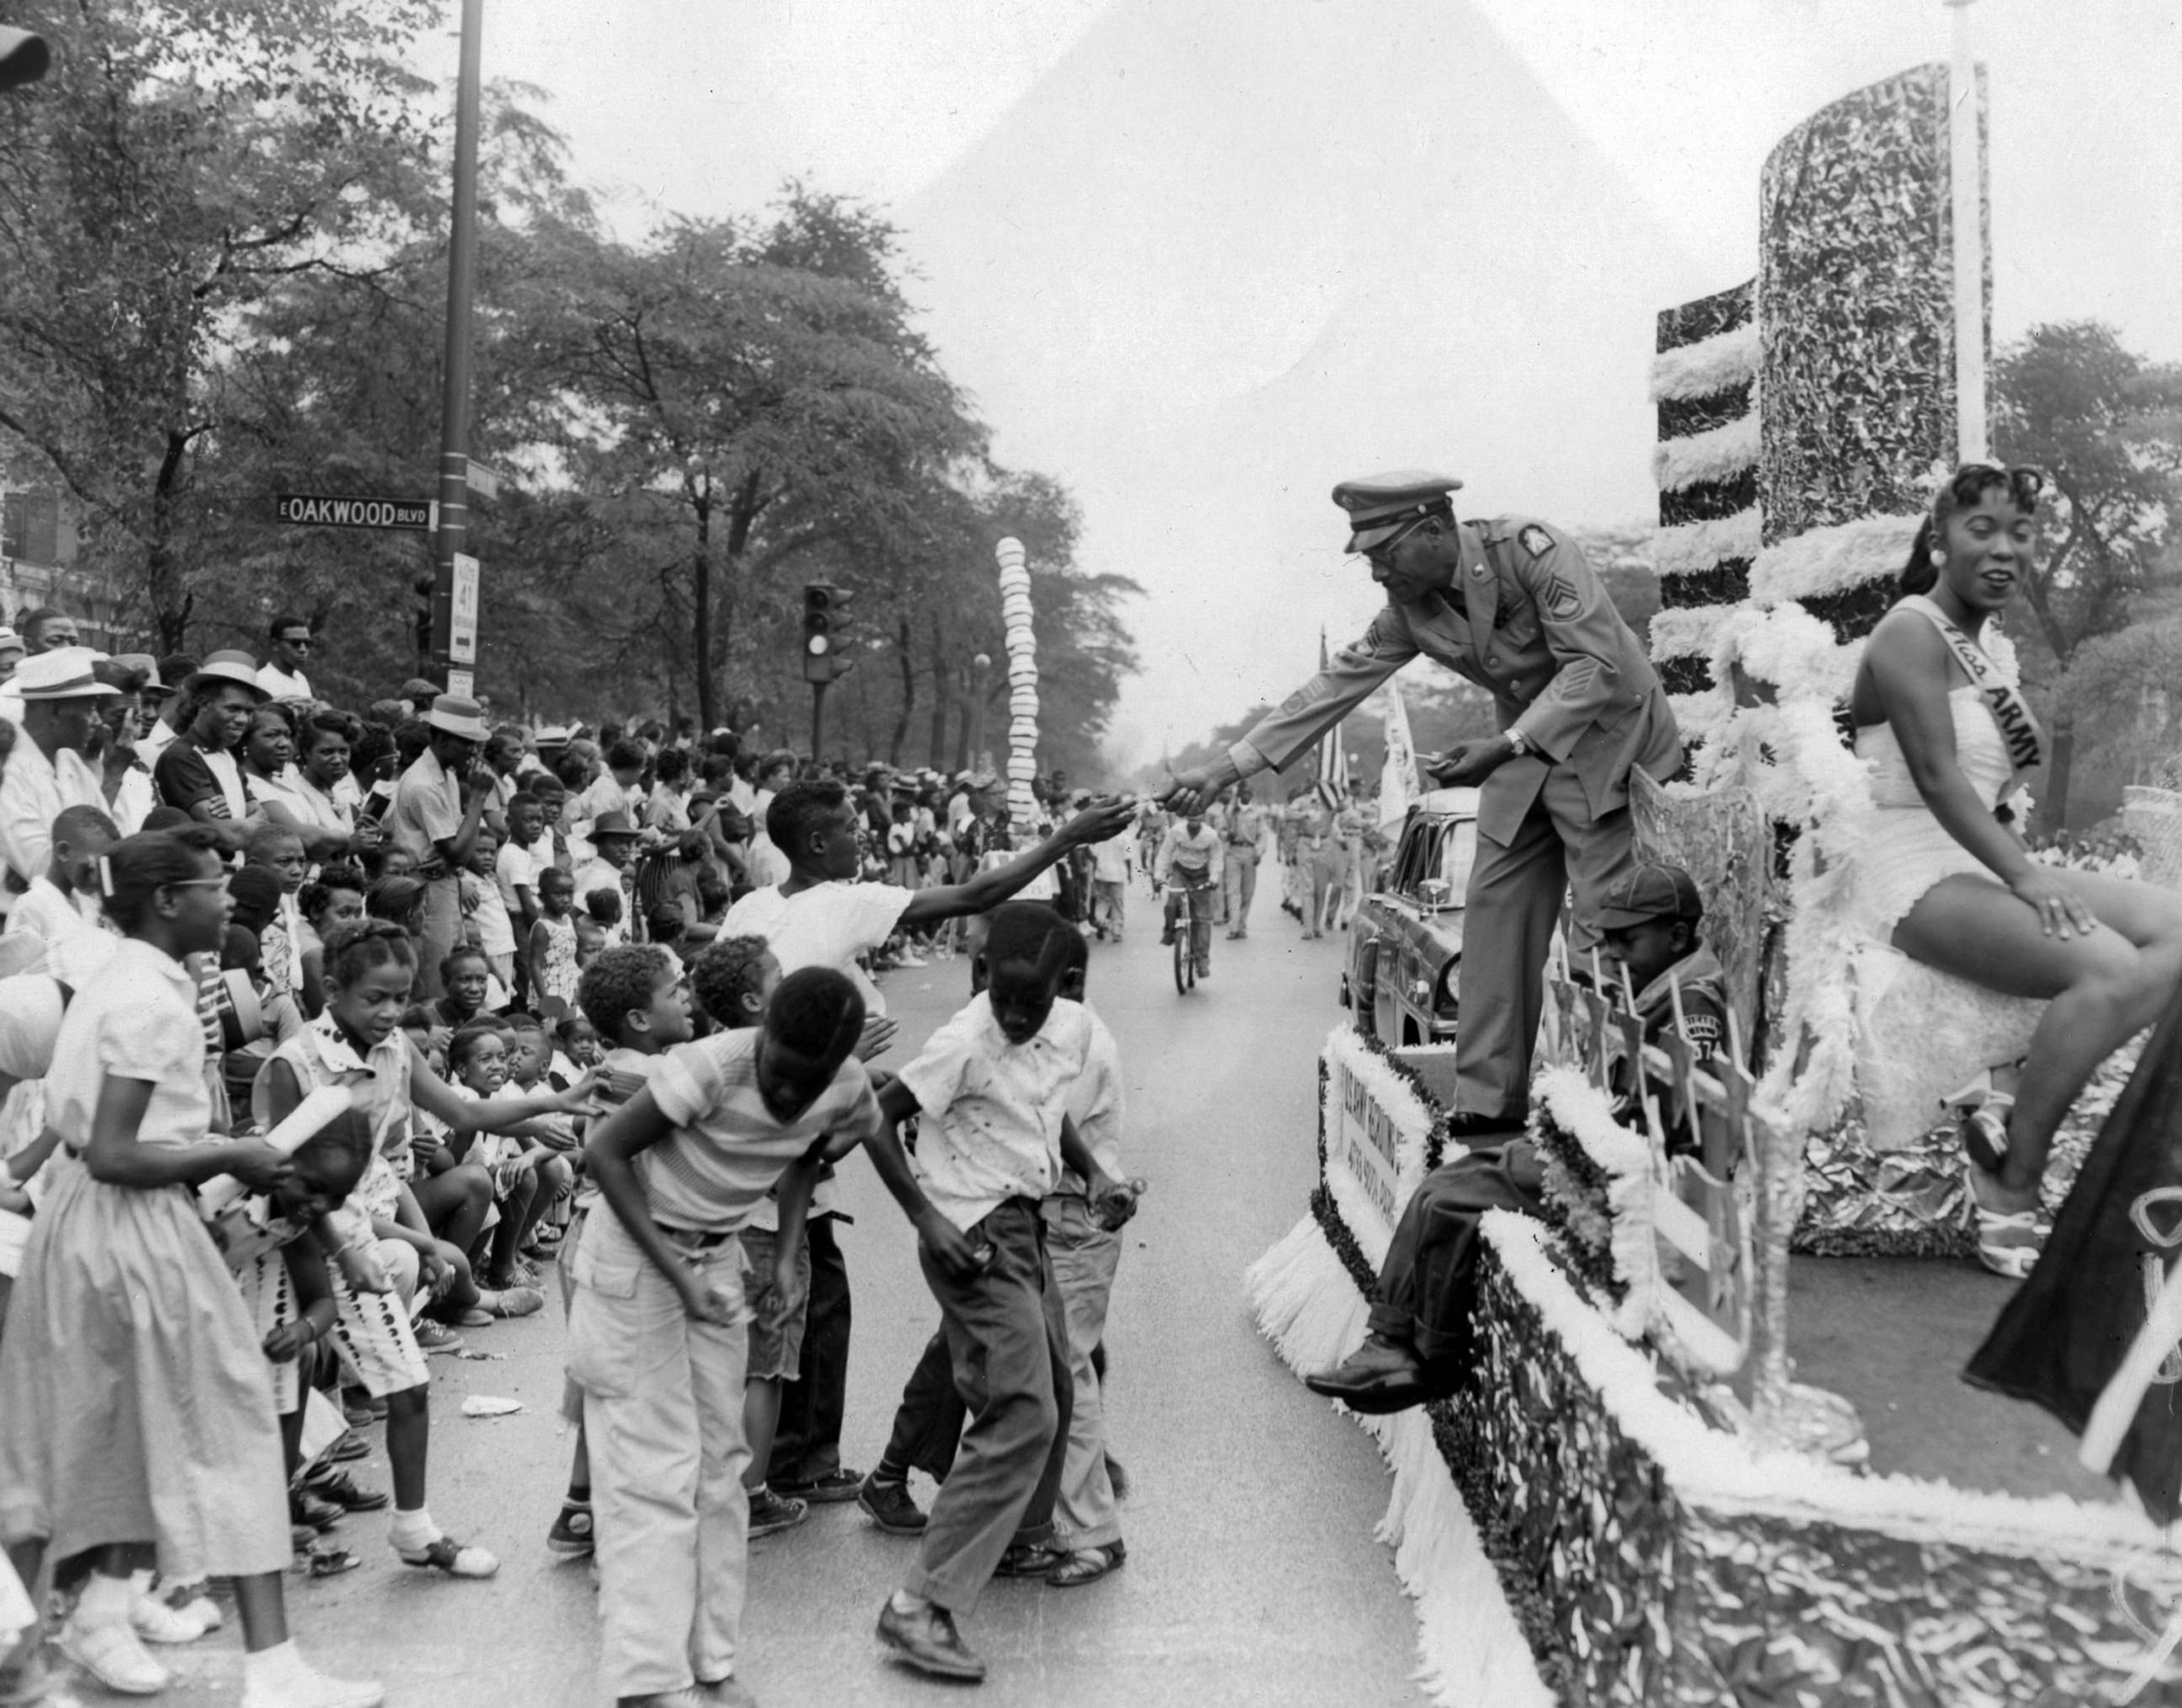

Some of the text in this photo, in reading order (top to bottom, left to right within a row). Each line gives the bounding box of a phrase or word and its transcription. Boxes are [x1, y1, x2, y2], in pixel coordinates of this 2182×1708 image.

[280, 499, 426, 526] E OAKWOOD BLVD
[1985, 686, 2041, 770] ARMY
